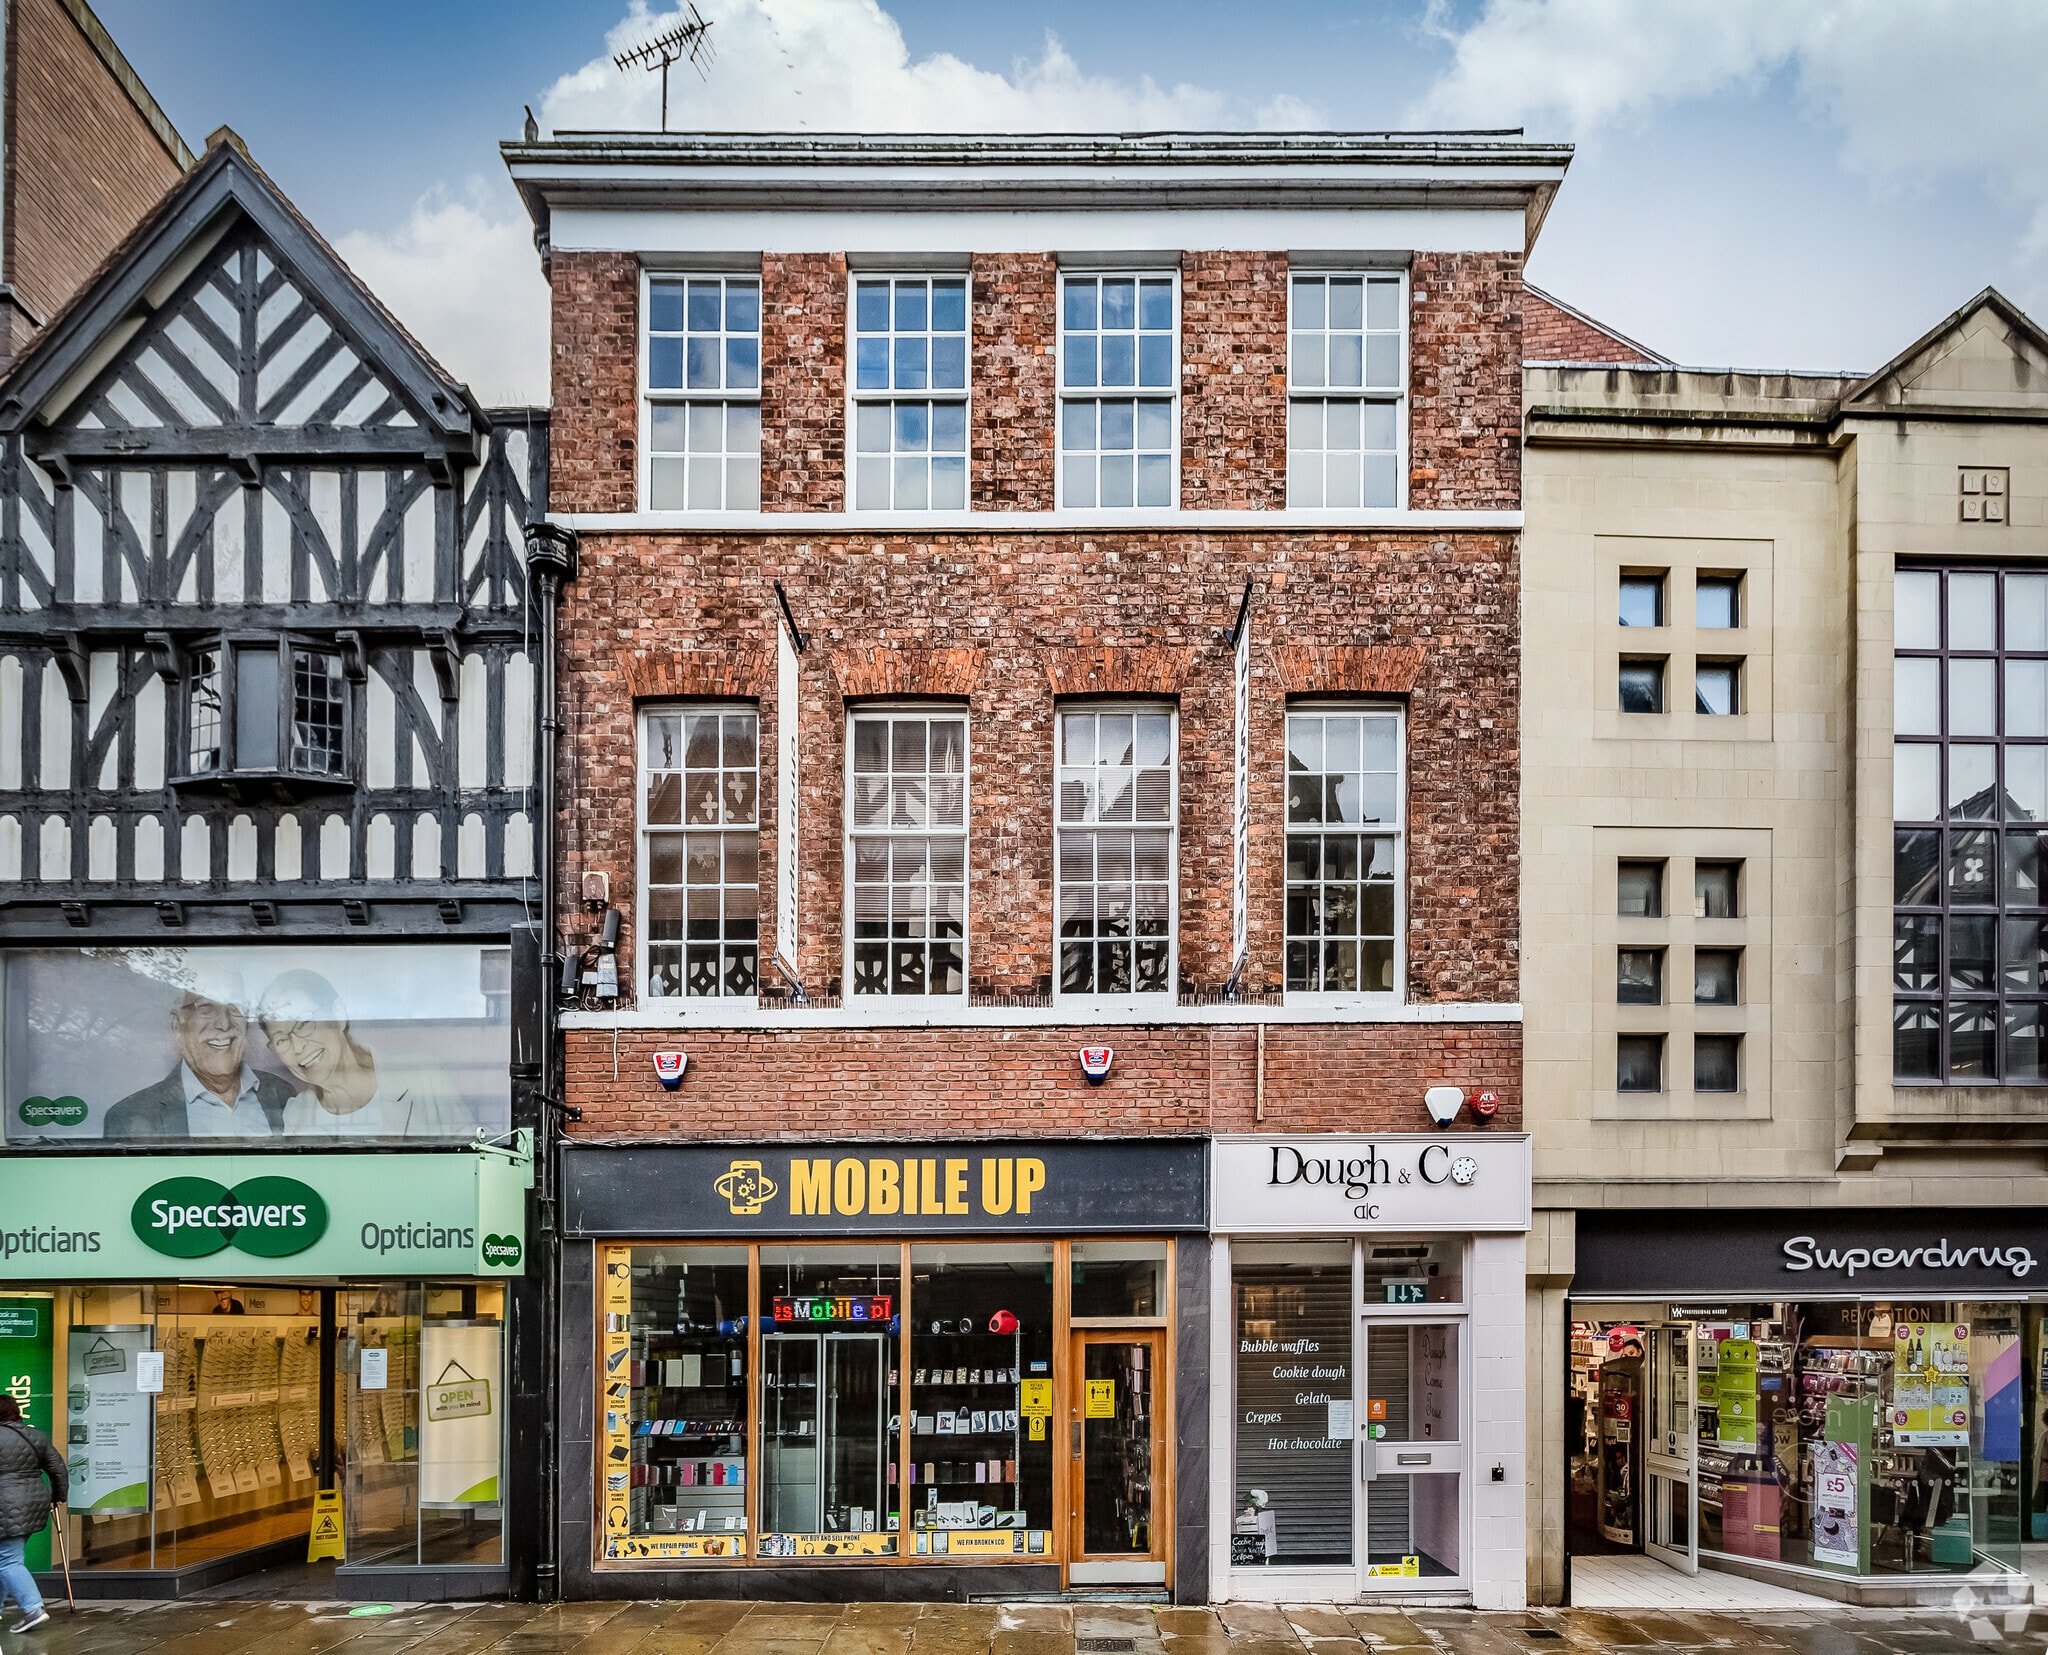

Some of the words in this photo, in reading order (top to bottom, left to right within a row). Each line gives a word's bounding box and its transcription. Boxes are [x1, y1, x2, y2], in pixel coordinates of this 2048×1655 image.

[25, 1104, 82, 1117] Specsavers
[1267, 1145, 1391, 1200] Dough
[1398, 1168, 1411, 1184] &
[789, 1158, 969, 1216] MOBILE
[982, 1158, 1046, 1215] UP
[151, 1199, 307, 1234] Specsavers
[361, 1222, 474, 1255] Opticians
[485, 1242, 519, 1257] Specsavers
[1783, 1236, 2038, 1277] Superdrug
[249, 1299, 265, 1309] Men
[1841, 1307, 1930, 1323] REVOTION
[1240, 1340, 1278, 1353] Bubble
[1281, 1339, 1320, 1354] waffles
[1272, 1365, 1309, 1378] Cookie
[1311, 1365, 1346, 1380] dough
[440, 1390, 474, 1404] OPEN
[1295, 1392, 1330, 1405] Gelato
[1245, 1411, 1282, 1425] Crepes
[1268, 1438, 1288, 1450] Hot
[1290, 1437, 1342, 1450] chocolate
[1827, 1477, 1845, 1493] £5
